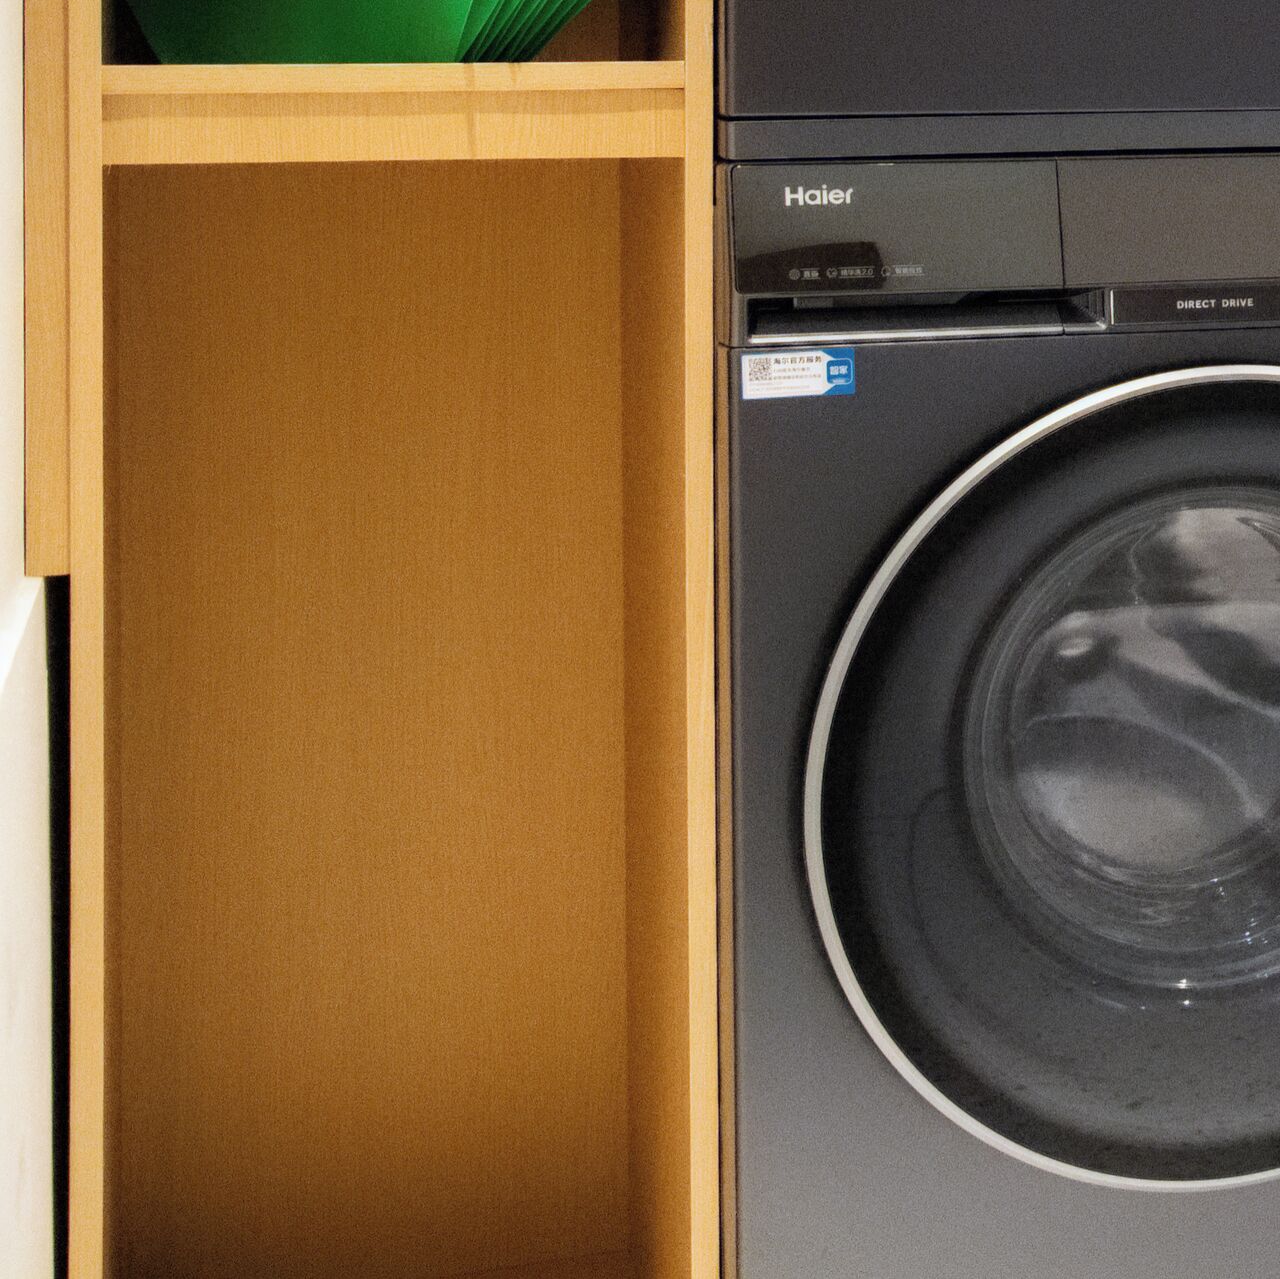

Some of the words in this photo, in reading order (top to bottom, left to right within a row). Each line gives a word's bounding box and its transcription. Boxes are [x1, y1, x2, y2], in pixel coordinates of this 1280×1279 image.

[784, 184, 853, 207] Haier
[1176, 299, 1216, 309] DIRECT
[1221, 298, 1254, 308] DRIVE
